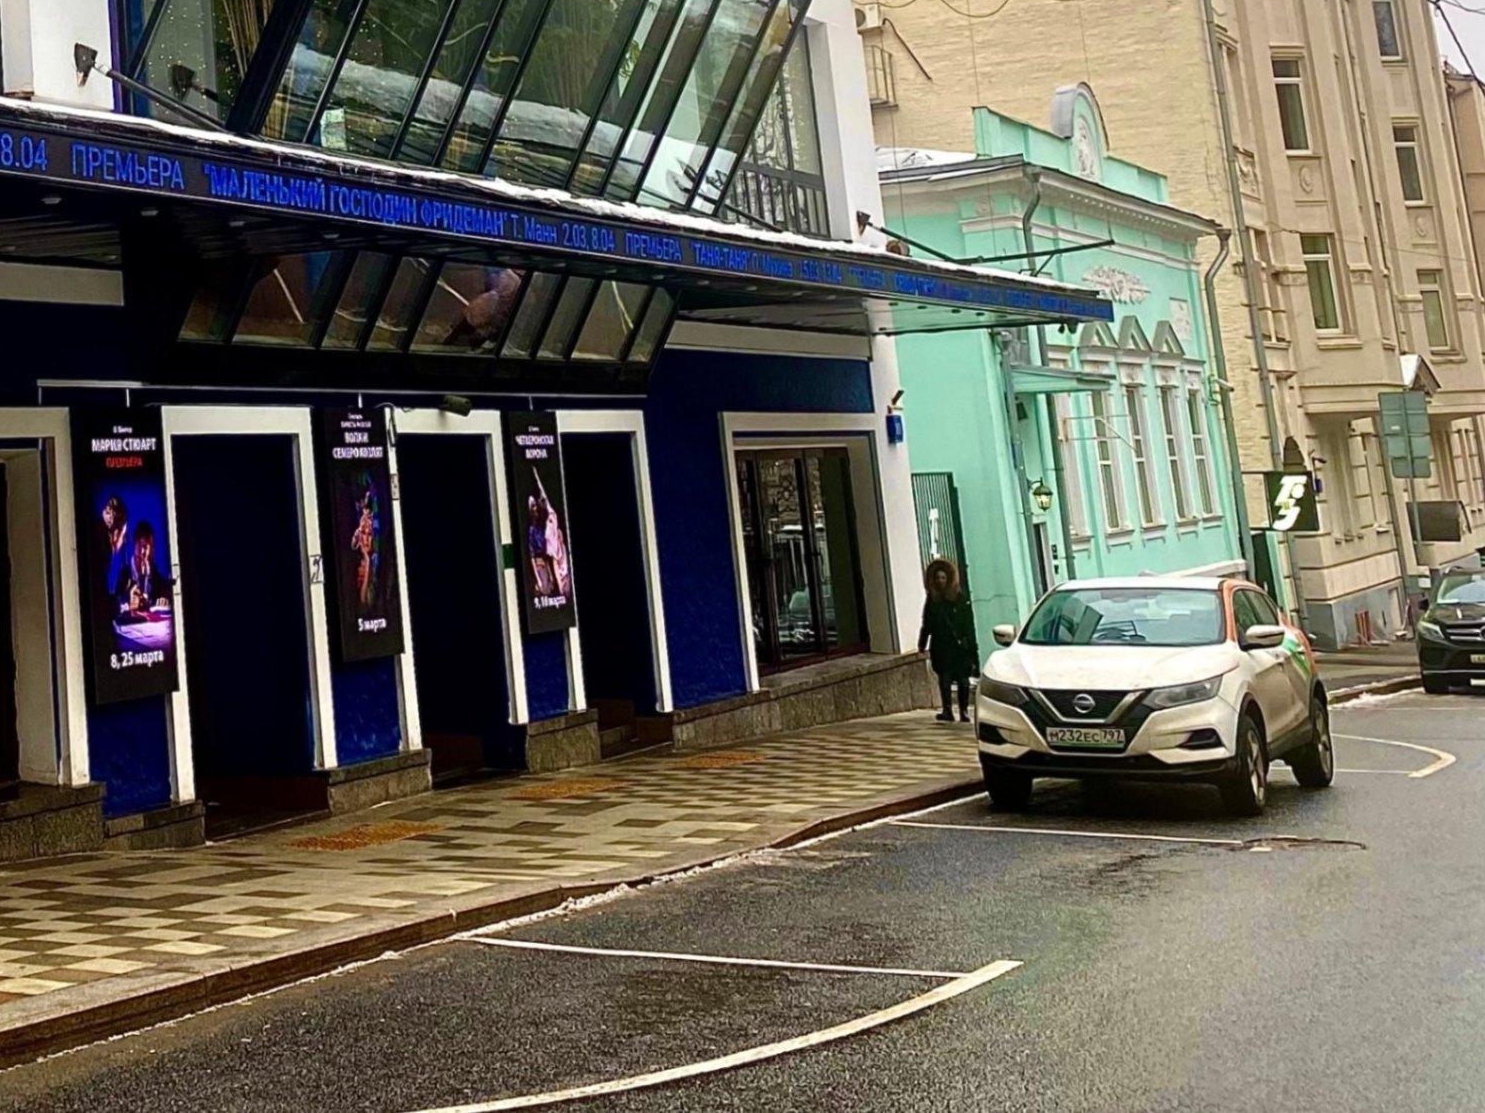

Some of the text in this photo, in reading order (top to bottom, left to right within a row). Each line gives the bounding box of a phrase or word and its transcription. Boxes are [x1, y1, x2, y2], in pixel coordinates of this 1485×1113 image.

[71, 143, 185, 190] ПРЕМЬЕРА
[329, 186, 417, 225] ГОСПОДИН
[625, 233, 683, 262] ПРЕМЬЕРА
[123, 438, 156, 452] СТЮАРТ
[358, 618, 364, 632] 5
[121, 651, 133, 667] 25
[134, 650, 164, 667] марта
